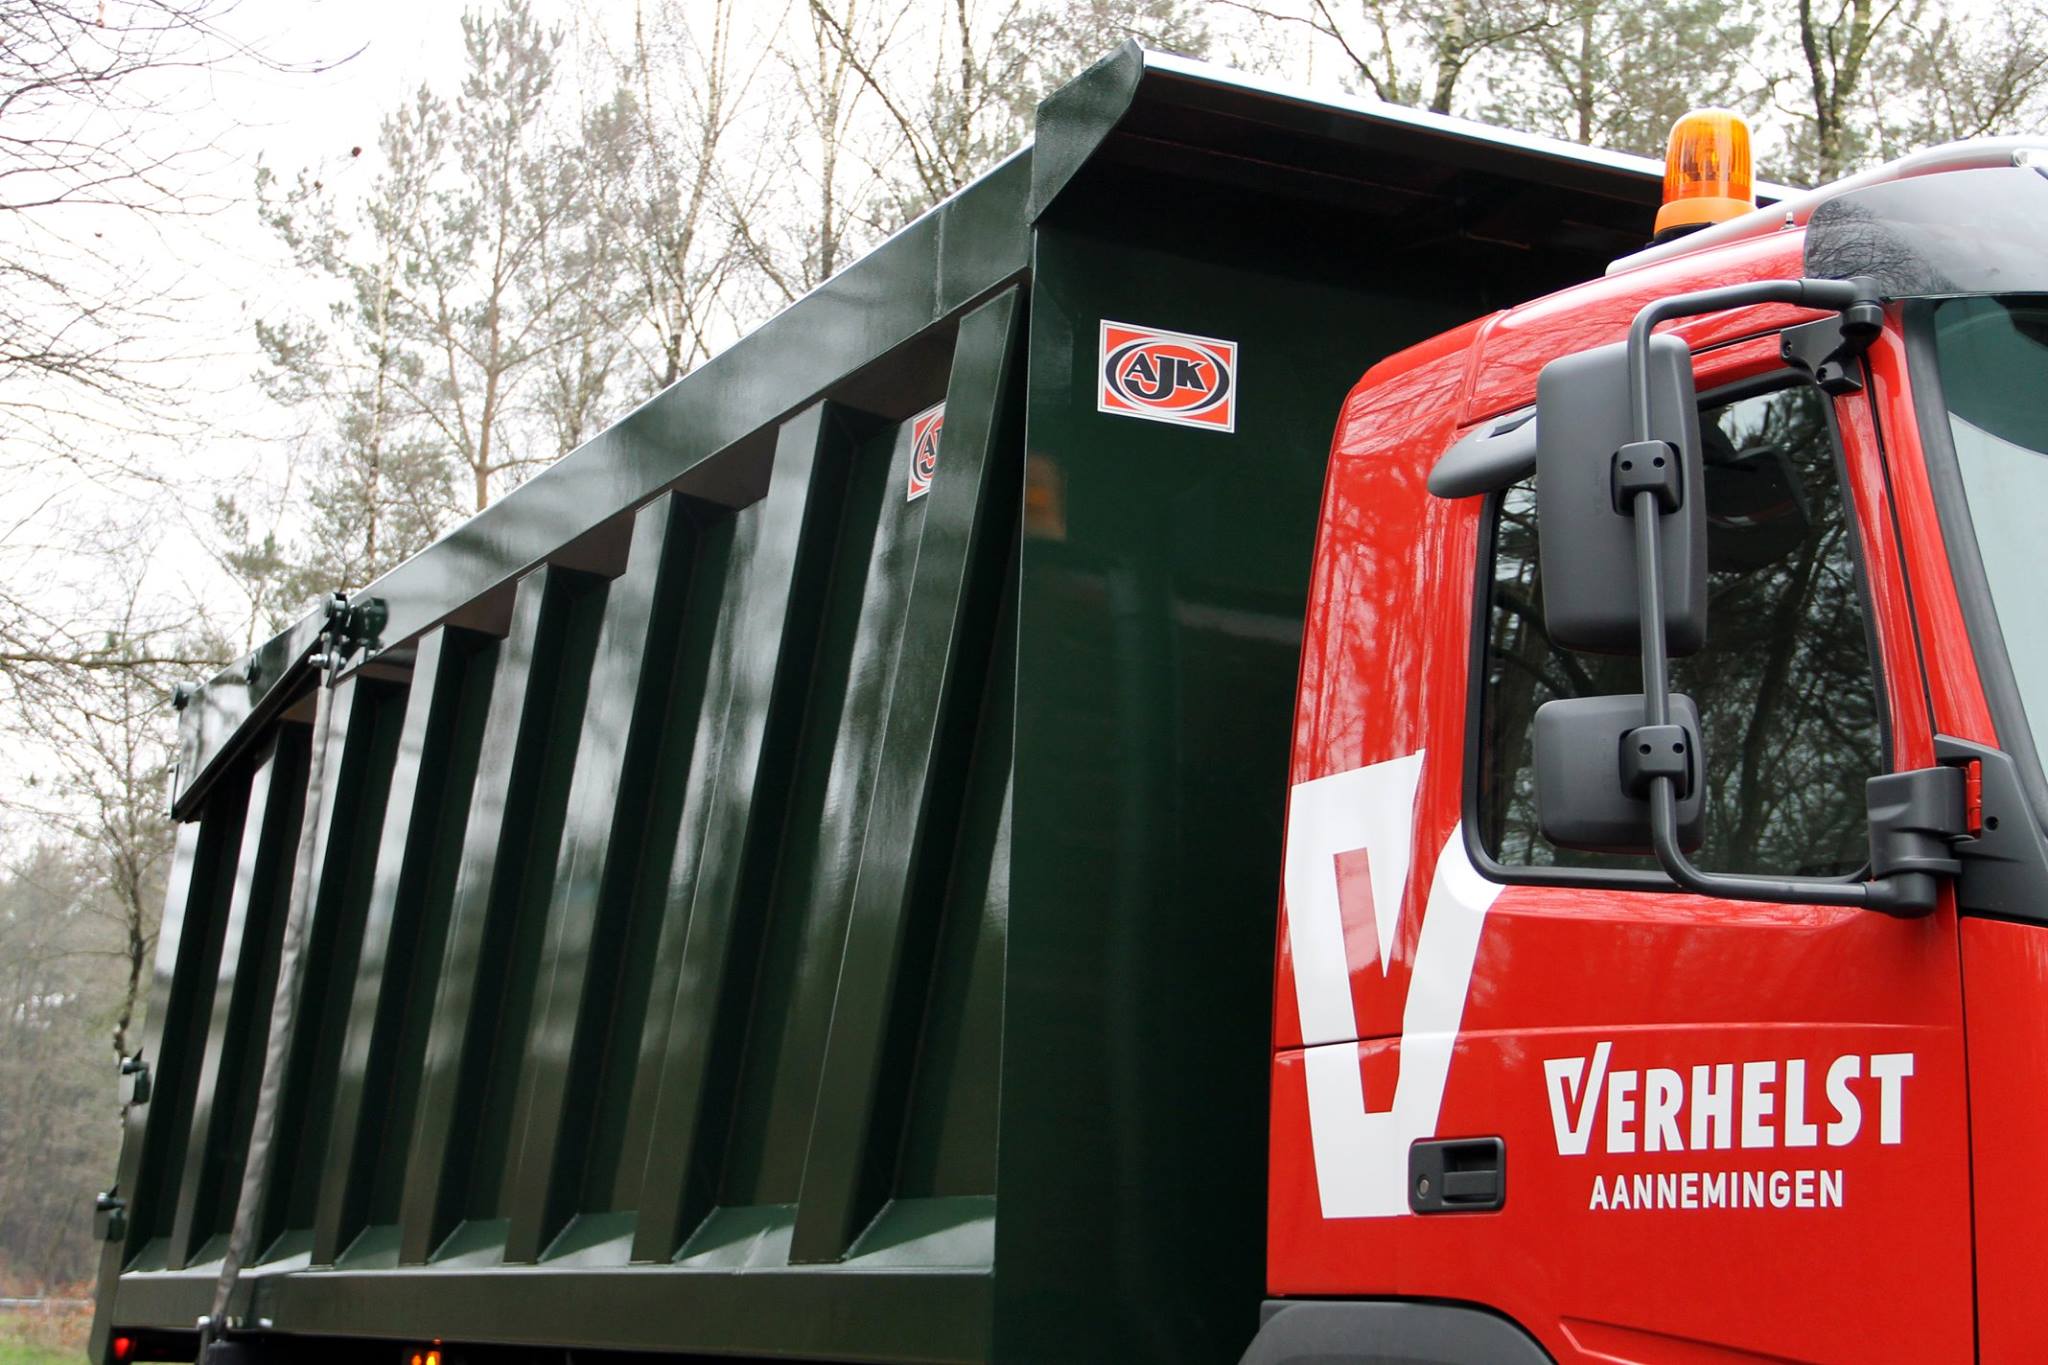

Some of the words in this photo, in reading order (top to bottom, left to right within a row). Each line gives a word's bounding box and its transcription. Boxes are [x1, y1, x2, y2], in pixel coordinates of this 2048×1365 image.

[1122, 351, 1208, 401] AJK
[1543, 1041, 1914, 1156] VERHELST
[1589, 1170, 1843, 1211] AANNEMINGEN
